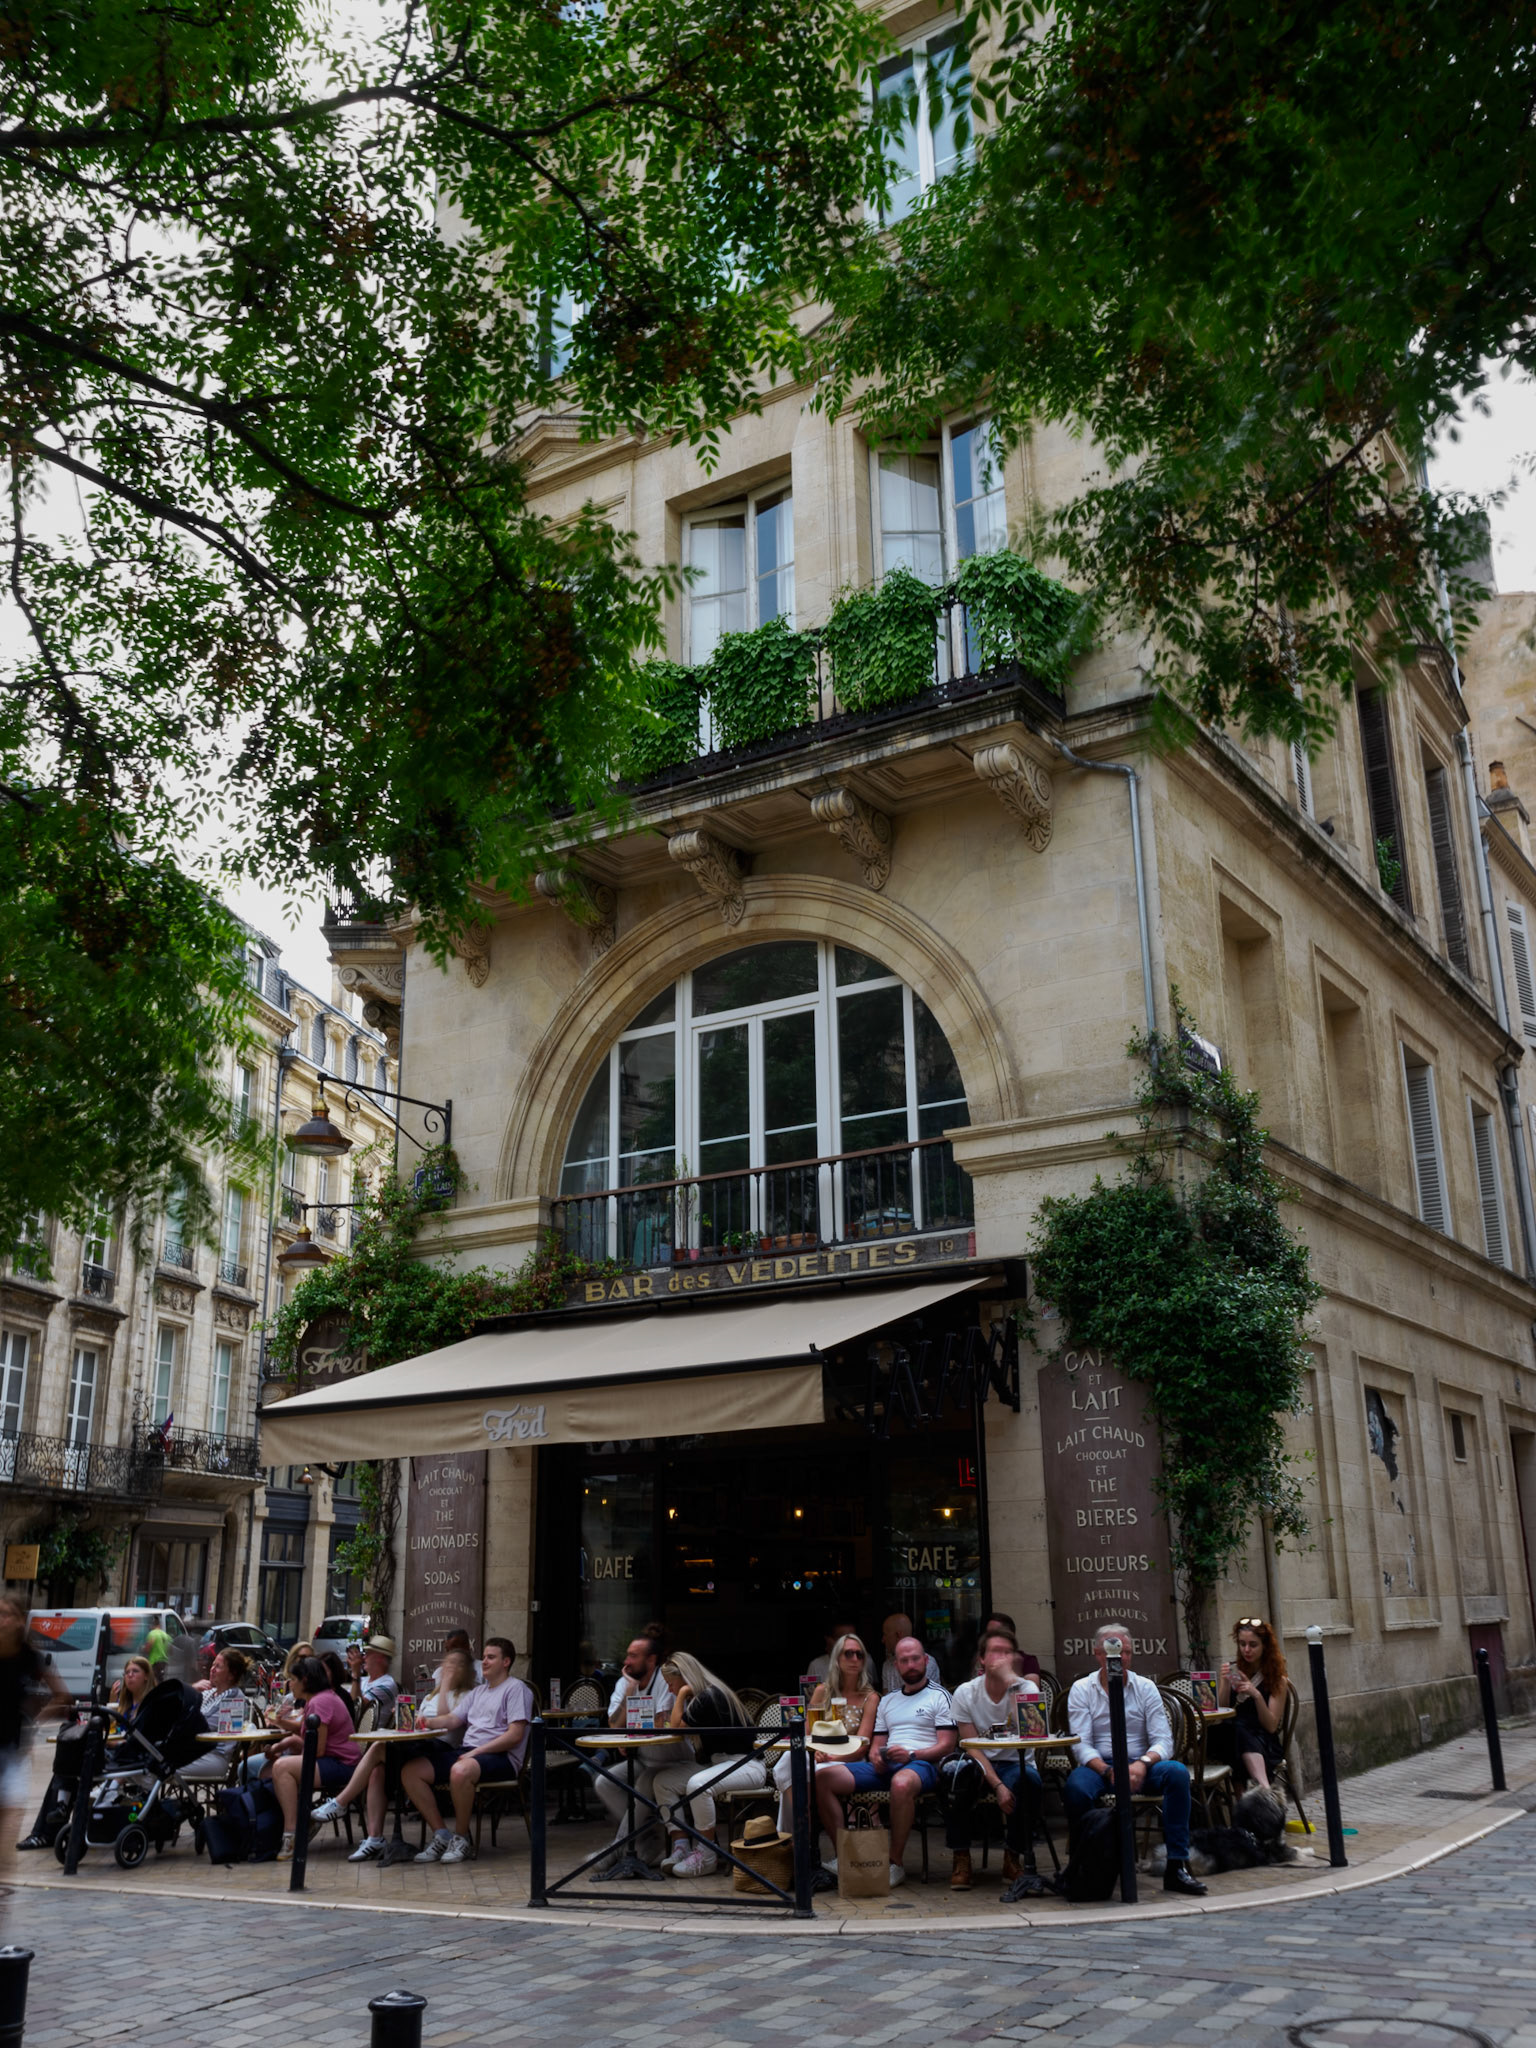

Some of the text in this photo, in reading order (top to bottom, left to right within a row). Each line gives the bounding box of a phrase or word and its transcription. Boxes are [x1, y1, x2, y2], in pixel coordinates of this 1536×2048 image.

[585, 1239, 954, 1303] BAR des VEDETTES 19
[302, 1342, 371, 1375] Fred
[1064, 1347, 1107, 1372] CAF
[1088, 1374, 1102, 1385] ET
[1071, 1386, 1123, 1412] LAIT
[483, 1403, 549, 1441] Fred
[1057, 1426, 1145, 1454] LAIT CHAUD
[1075, 1448, 1127, 1461] CHOCOLAT
[418, 1467, 475, 1490] LAIT CHAUD
[1095, 1465, 1108, 1476] ET
[428, 1486, 463, 1496] CHOCOLAT
[440, 1499, 449, 1508] ET
[1076, 1507, 1138, 1527] BIERES
[410, 1532, 479, 1550] LIMONADES
[1100, 1534, 1112, 1545] ET
[438, 1555, 447, 1564] ET
[594, 1554, 634, 1579] CAFÉ
[908, 1545, 957, 1571] CAFÉ
[1066, 1554, 1149, 1573] LIQUEURS
[424, 1570, 461, 1585] SODAS
